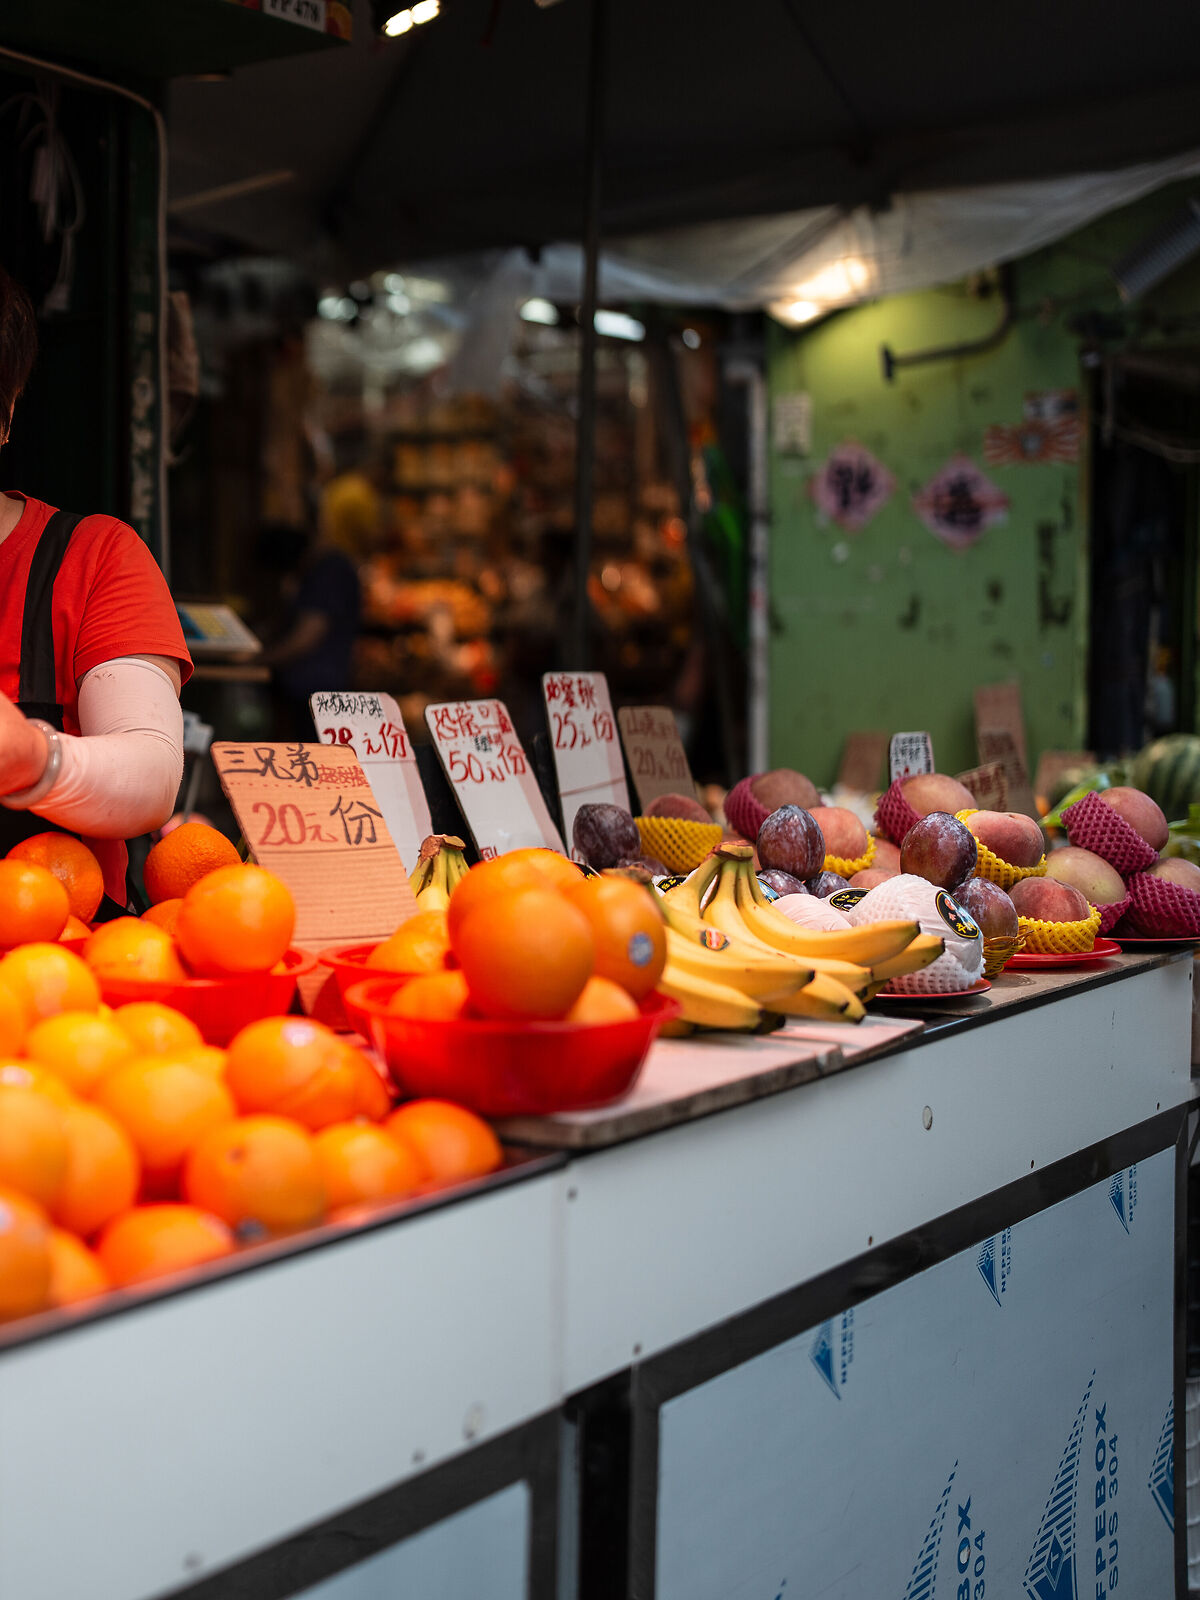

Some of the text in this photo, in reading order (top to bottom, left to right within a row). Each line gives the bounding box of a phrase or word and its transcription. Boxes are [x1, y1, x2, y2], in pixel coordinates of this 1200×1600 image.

[222, 743, 320, 788] 三兄弟
[1108, 1434, 1119, 1591] SUS 304
